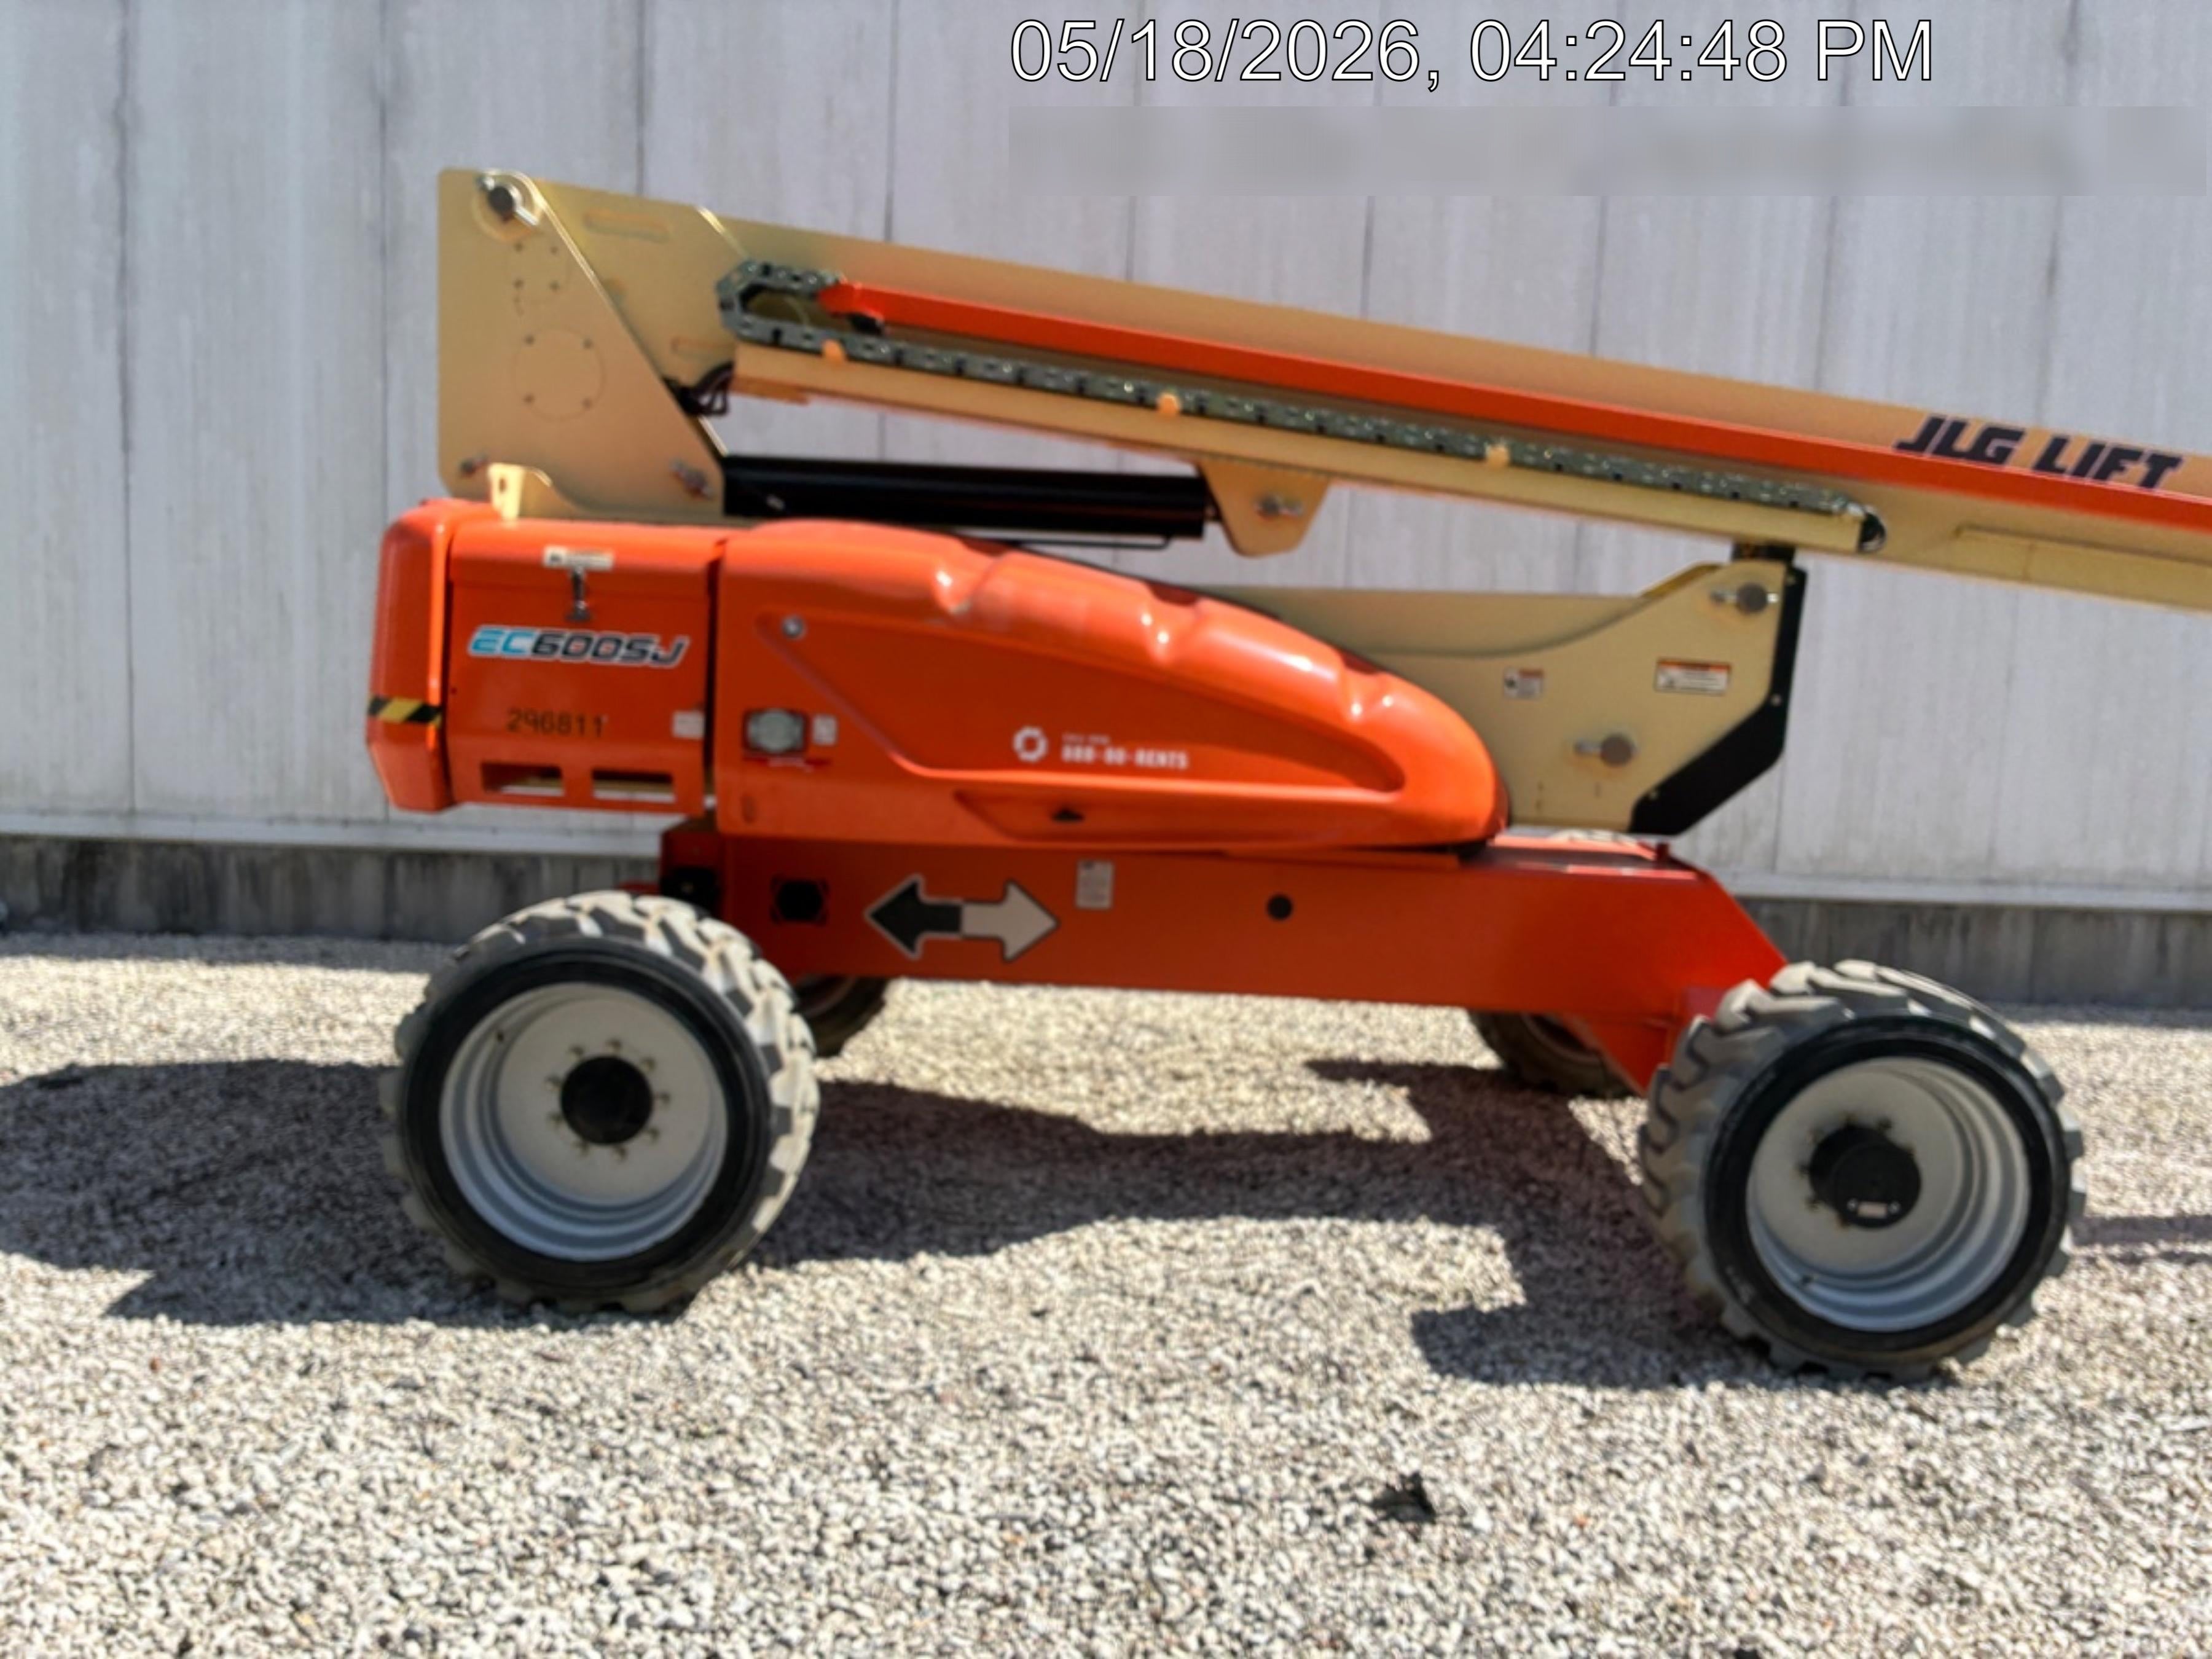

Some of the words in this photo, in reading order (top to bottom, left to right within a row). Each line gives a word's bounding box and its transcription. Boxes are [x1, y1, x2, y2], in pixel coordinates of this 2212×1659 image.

[1895, 414, 2025, 465] JLG
[2032, 434, 2184, 489] LIFT
[469, 626, 689, 667] EC600SJ
